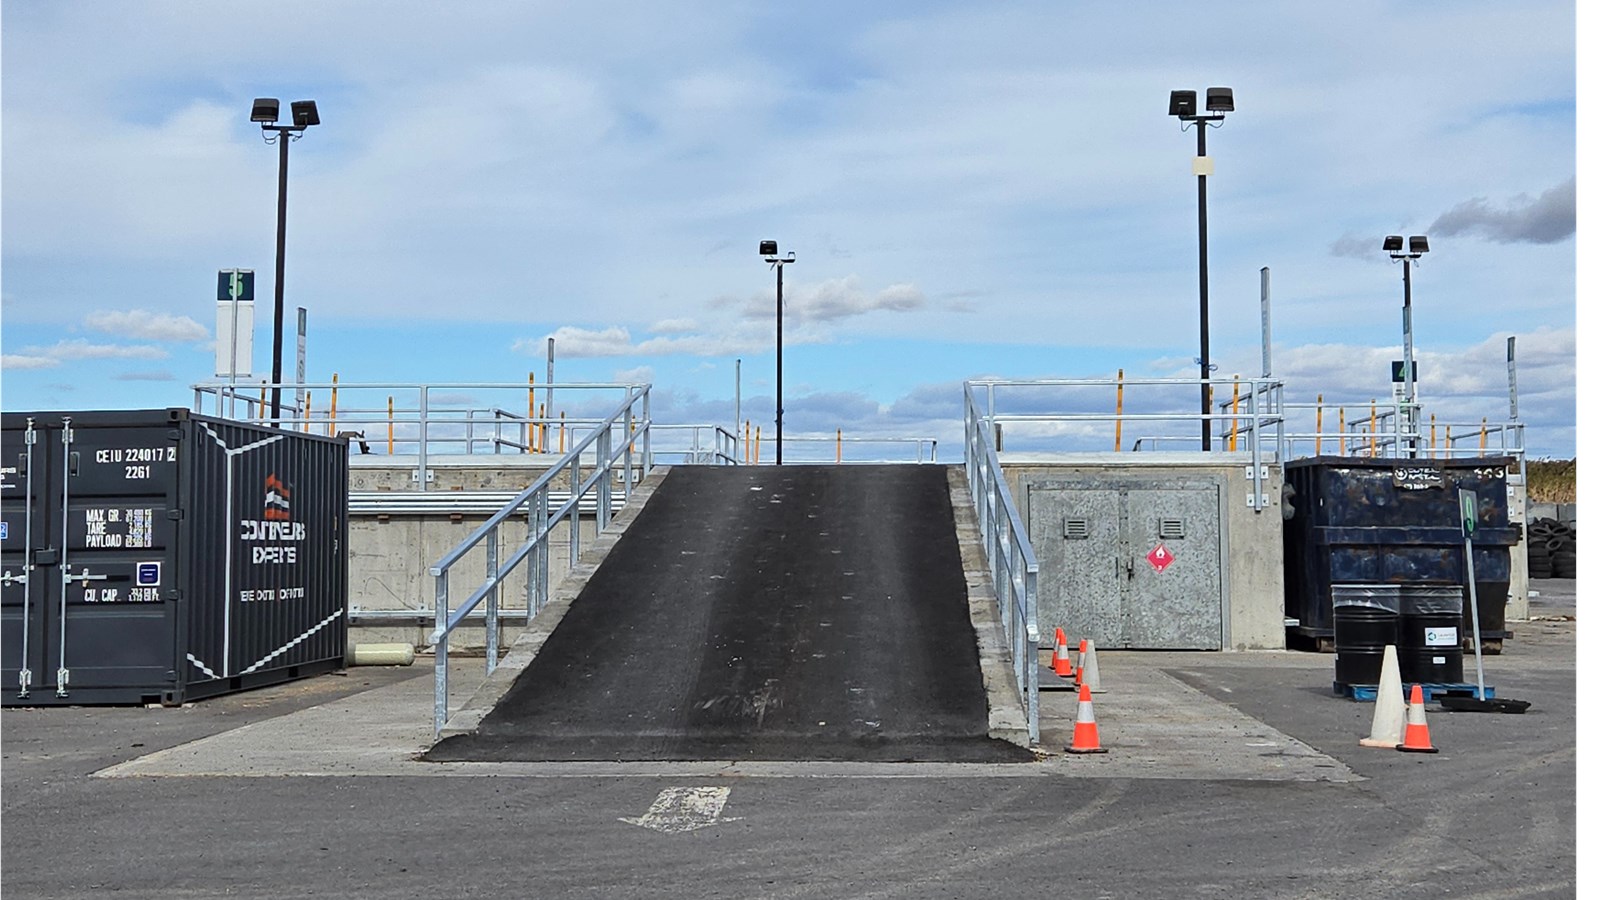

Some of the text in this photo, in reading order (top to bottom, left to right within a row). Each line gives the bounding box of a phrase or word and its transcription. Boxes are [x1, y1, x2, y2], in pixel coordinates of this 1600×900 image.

[229, 274, 243, 296] 5
[96, 447, 176, 463] CEIU 224017 2
[87, 522, 106, 535] TARE
[86, 534, 122, 548] PAYLOAD
